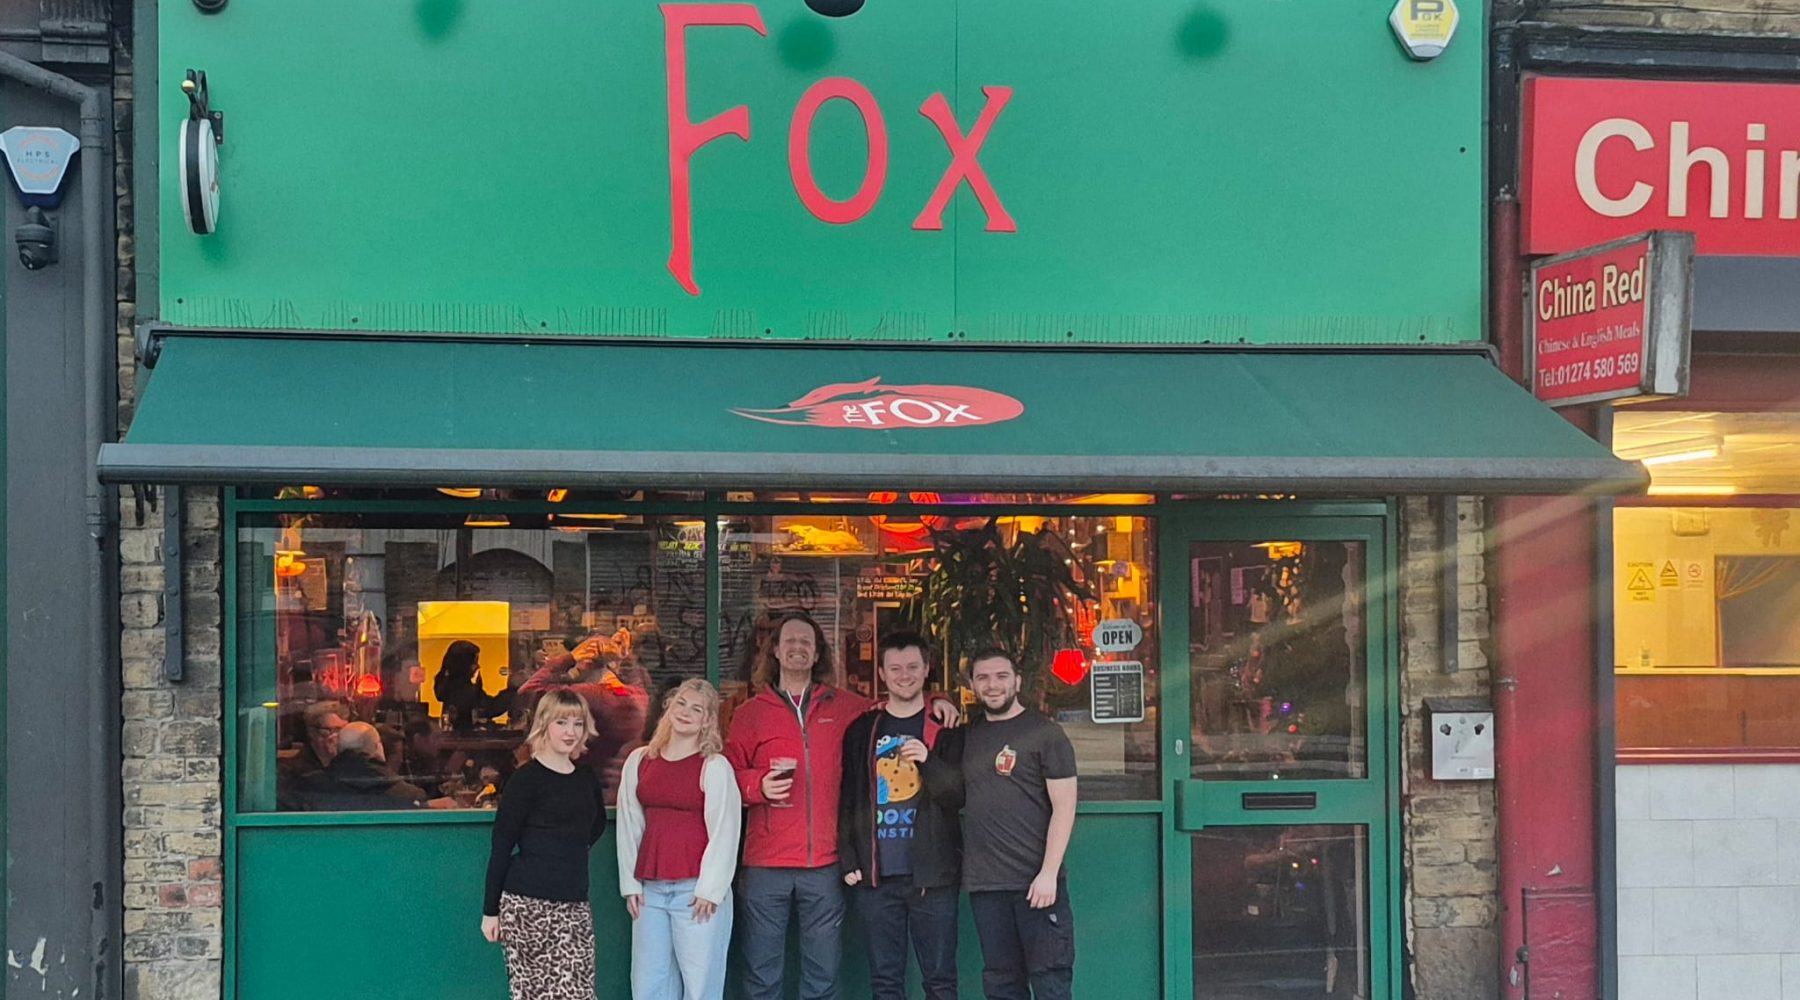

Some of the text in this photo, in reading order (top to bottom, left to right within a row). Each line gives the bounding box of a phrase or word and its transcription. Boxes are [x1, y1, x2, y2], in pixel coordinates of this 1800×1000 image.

[1539, 257, 1645, 321] China Red
[1538, 338, 1570, 355] Chinese
[1580, 325, 1613, 349] English
[1614, 321, 1640, 341] Meals
[1538, 352, 1639, 387] Tel:01274 580 569
[1102, 630, 1133, 645] OPEN
